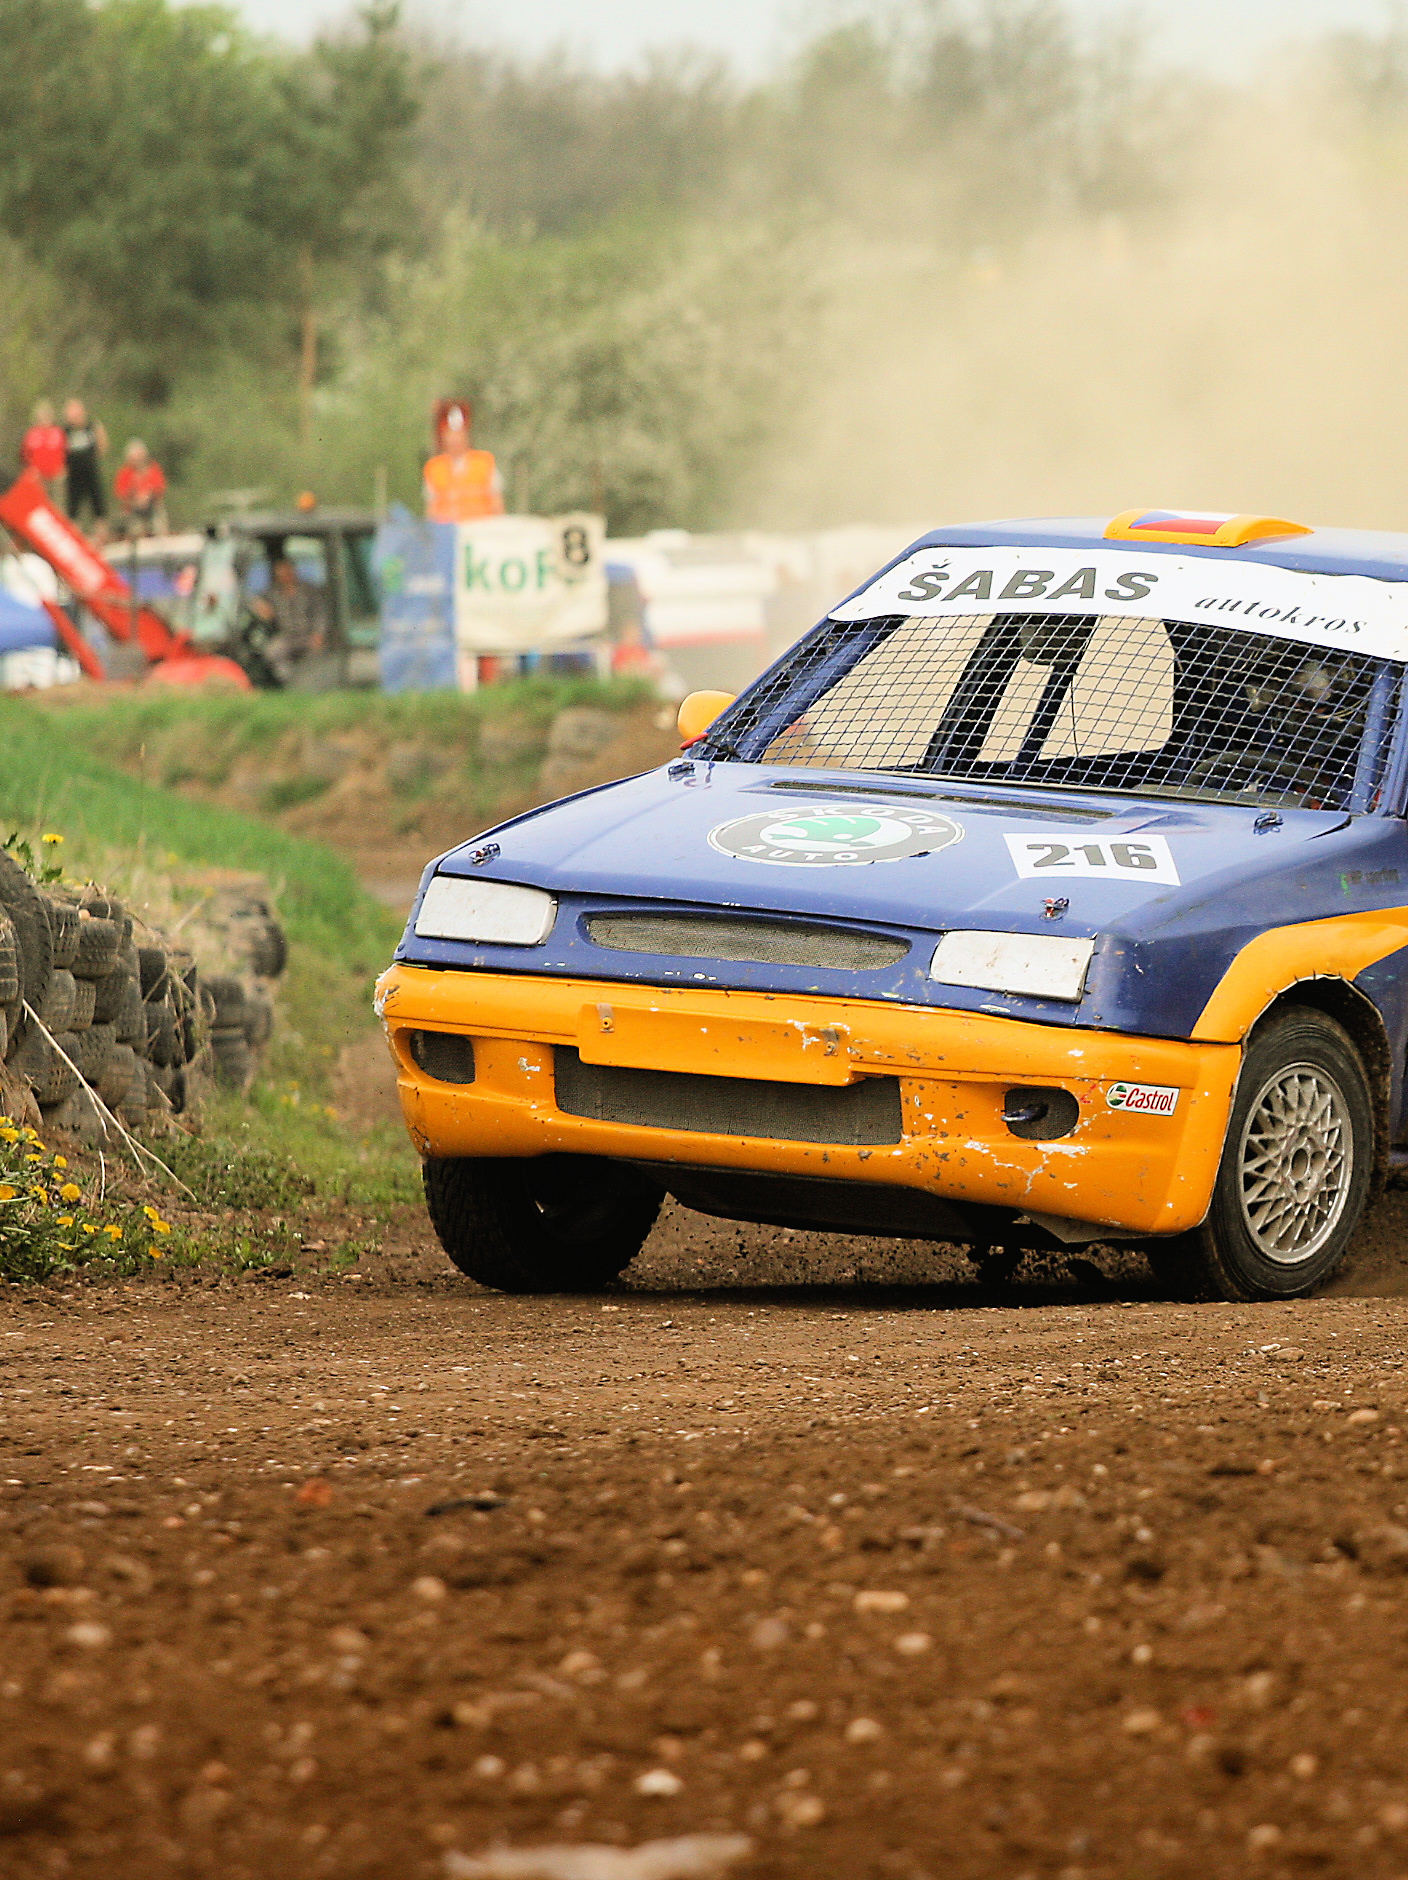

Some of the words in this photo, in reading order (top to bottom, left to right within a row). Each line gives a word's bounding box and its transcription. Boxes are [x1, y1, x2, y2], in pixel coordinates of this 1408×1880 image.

[563, 526, 589, 567] 8
[897, 562, 1159, 601] ŠABAS
[1194, 597, 1368, 634] autokros
[742, 844, 859, 862] AUTO
[1026, 843, 1158, 869] 216
[1125, 1087, 1174, 1111] Castrol
